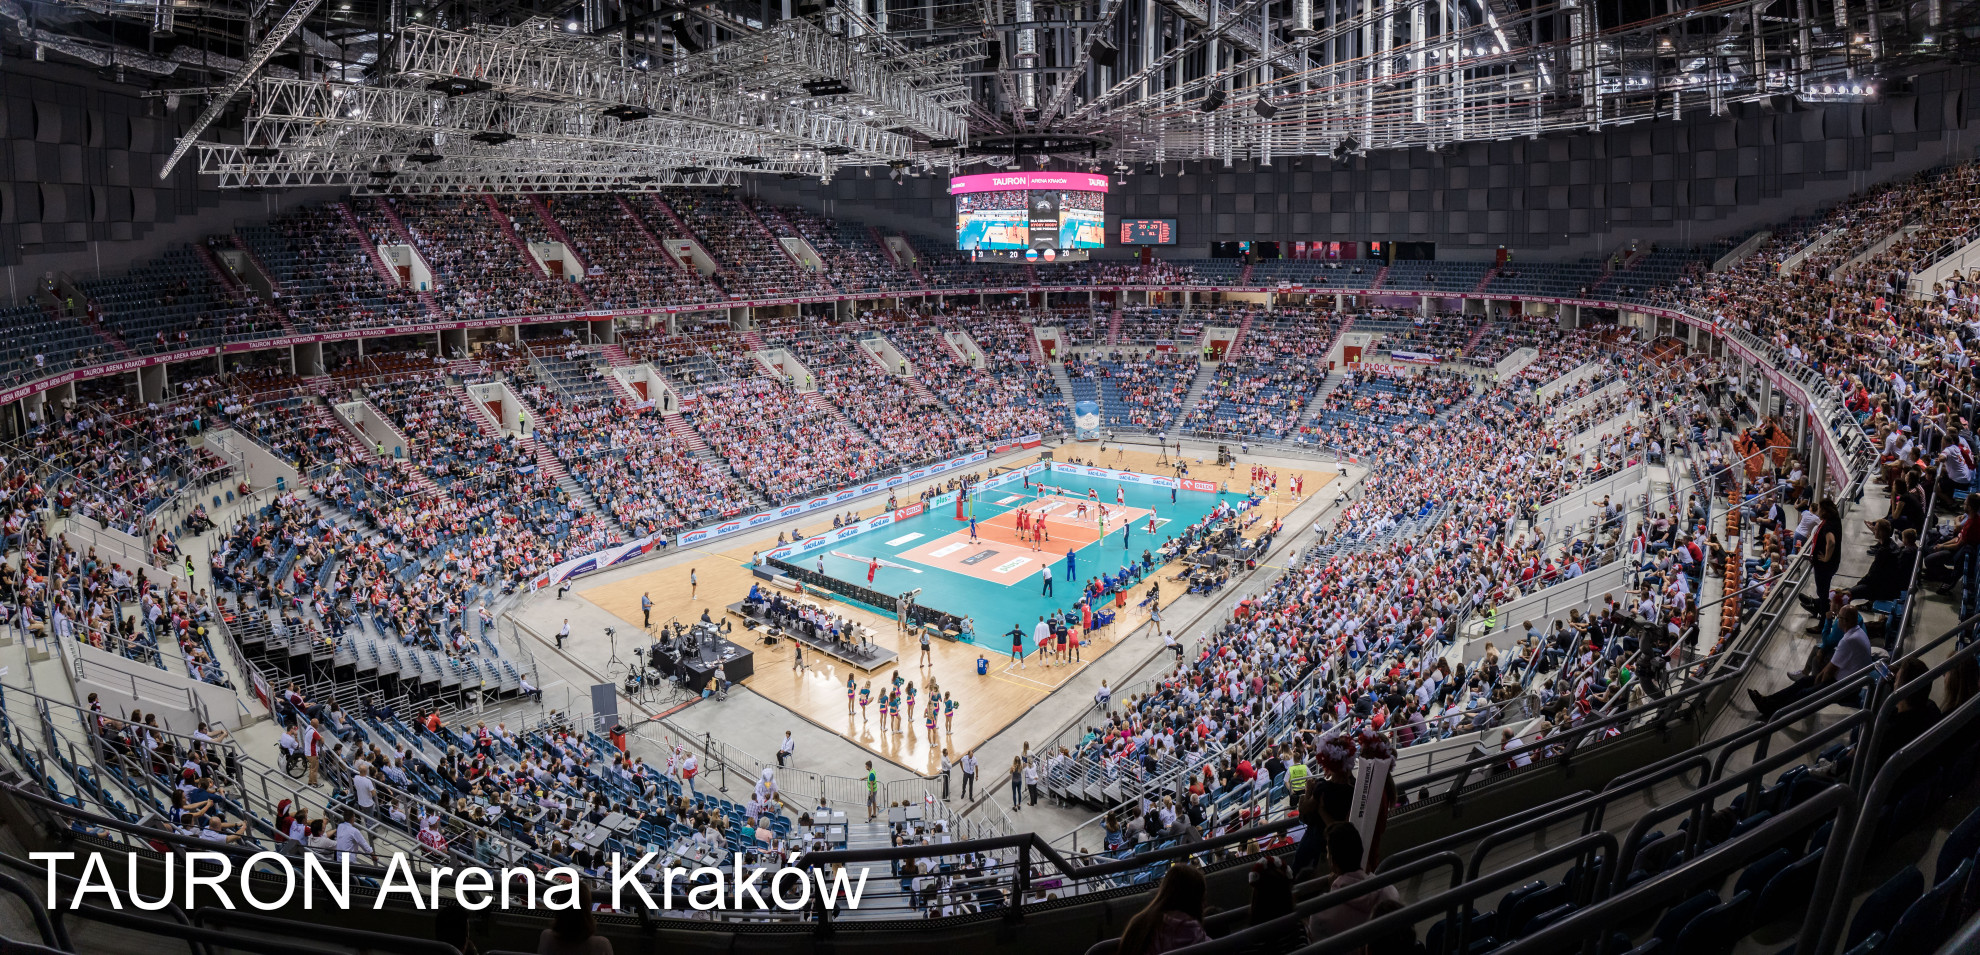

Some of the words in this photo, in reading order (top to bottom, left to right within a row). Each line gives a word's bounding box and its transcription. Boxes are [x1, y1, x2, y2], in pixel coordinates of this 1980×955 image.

[154, 355, 172, 363] TAURON
[190, 348, 209, 358] KRAKÓW
[83, 367, 105, 376] TAURON
[106, 364, 124, 372] ARENA
[125, 359, 146, 369] KRAKÓW
[1364, 363, 1389, 373] PŁOCK
[35, 382, 49, 391] TAURON
[50, 378, 60, 387] ARENA
[0, 394, 14, 403] ARENA
[14, 387, 31, 399] KRAKÓW
[936, 496, 948, 506] plus
[781, 506, 801, 517] DACHLAND
[906, 505, 921, 515] ORLEN
[750, 516, 770, 525] DACHLAND
[870, 518, 890, 528] DACHLAND
[718, 524, 739, 534] DACHLAND
[838, 529, 858, 539] DACHLAND
[684, 533, 707, 543] DACHLAND
[803, 539, 826, 550] DACHLAND
[772, 551, 791, 559] CHLAND
